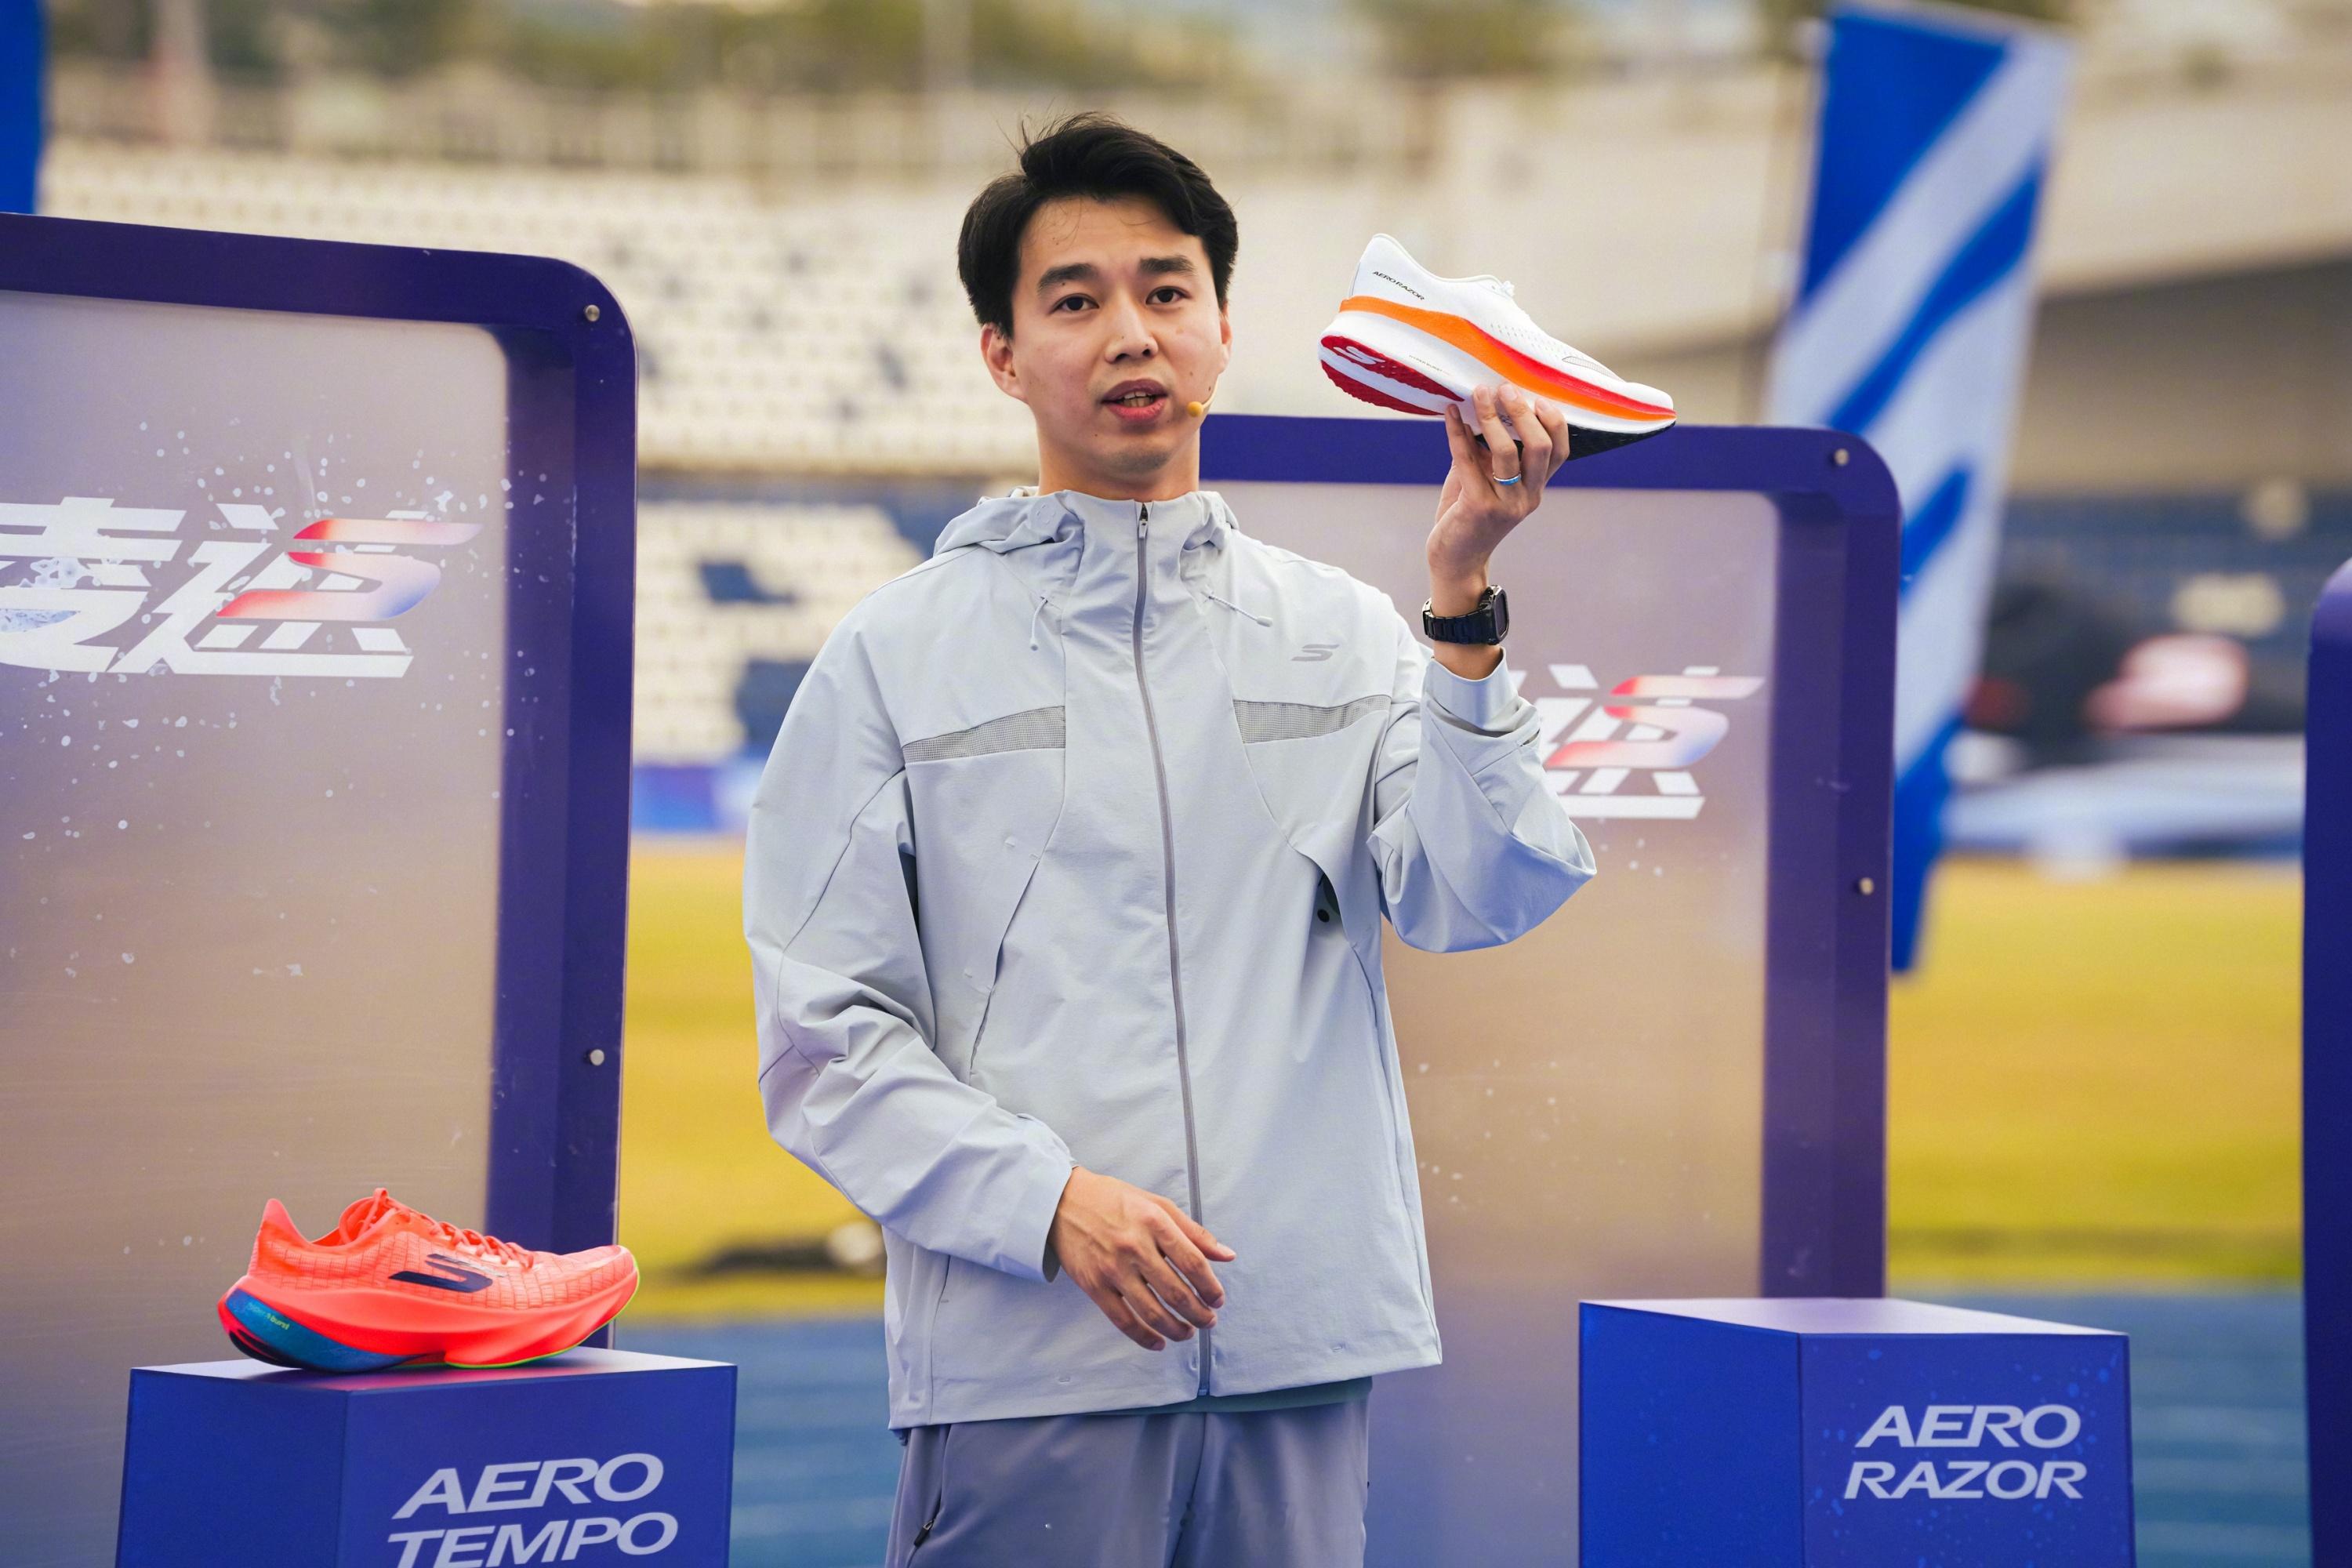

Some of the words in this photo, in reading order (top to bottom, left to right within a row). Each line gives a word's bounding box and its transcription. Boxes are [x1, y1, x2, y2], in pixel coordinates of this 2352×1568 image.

[1373, 271, 1396, 283] AERO
[1396, 281, 1425, 300] RAZOR
[1854, 1404, 2082, 1448] AERO
[391, 1453, 664, 1519] AERO
[1844, 1460, 2087, 1500] RAZOR
[387, 1512, 679, 1568] TEMPO
